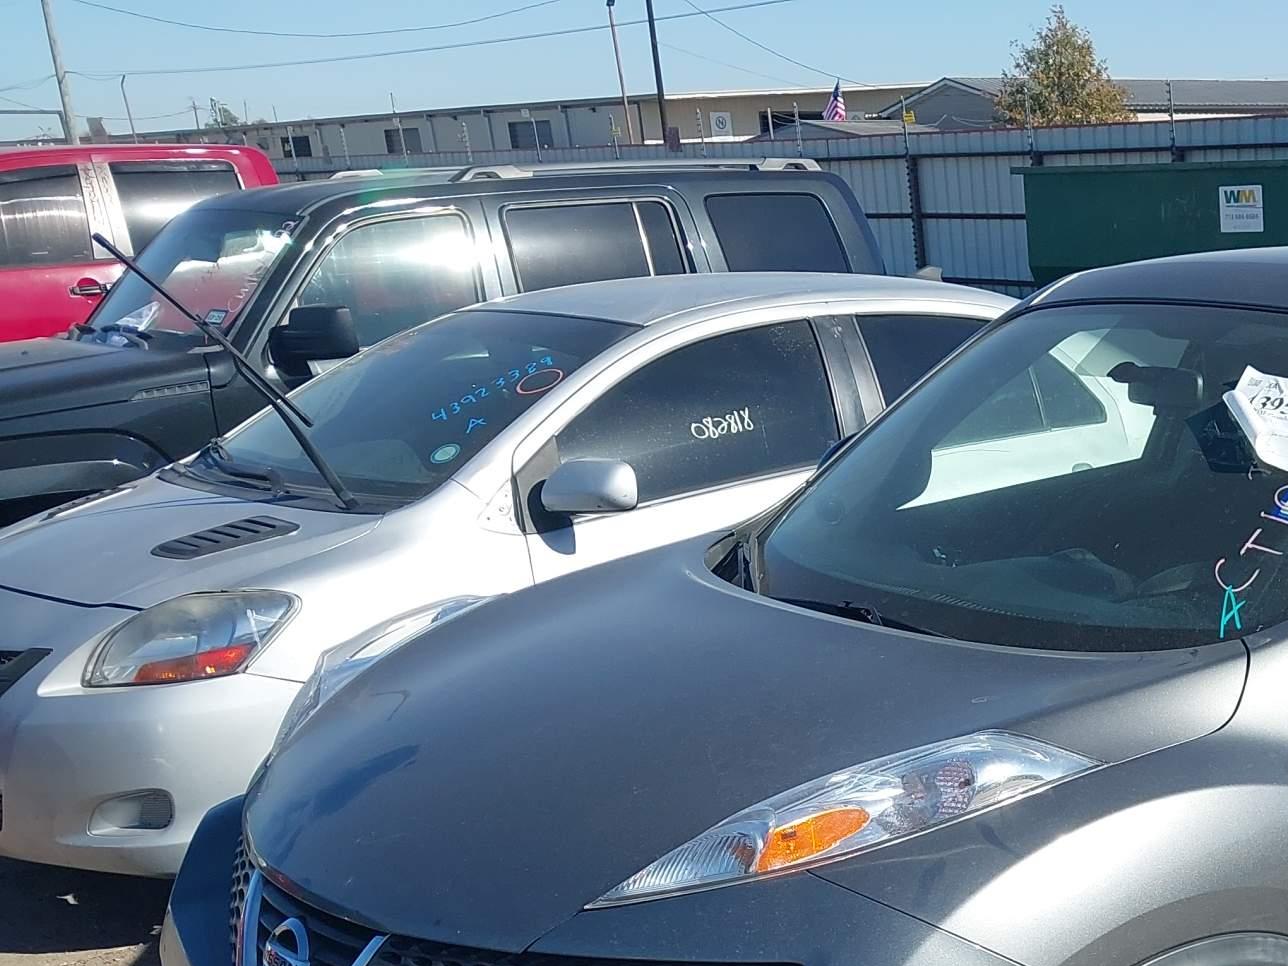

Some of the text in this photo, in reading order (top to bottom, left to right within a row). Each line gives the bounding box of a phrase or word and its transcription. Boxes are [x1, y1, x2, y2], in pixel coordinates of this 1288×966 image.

[1224, 190, 1257, 203] WM
[691, 407, 754, 438] 082818
[1219, 585, 1247, 638] A
